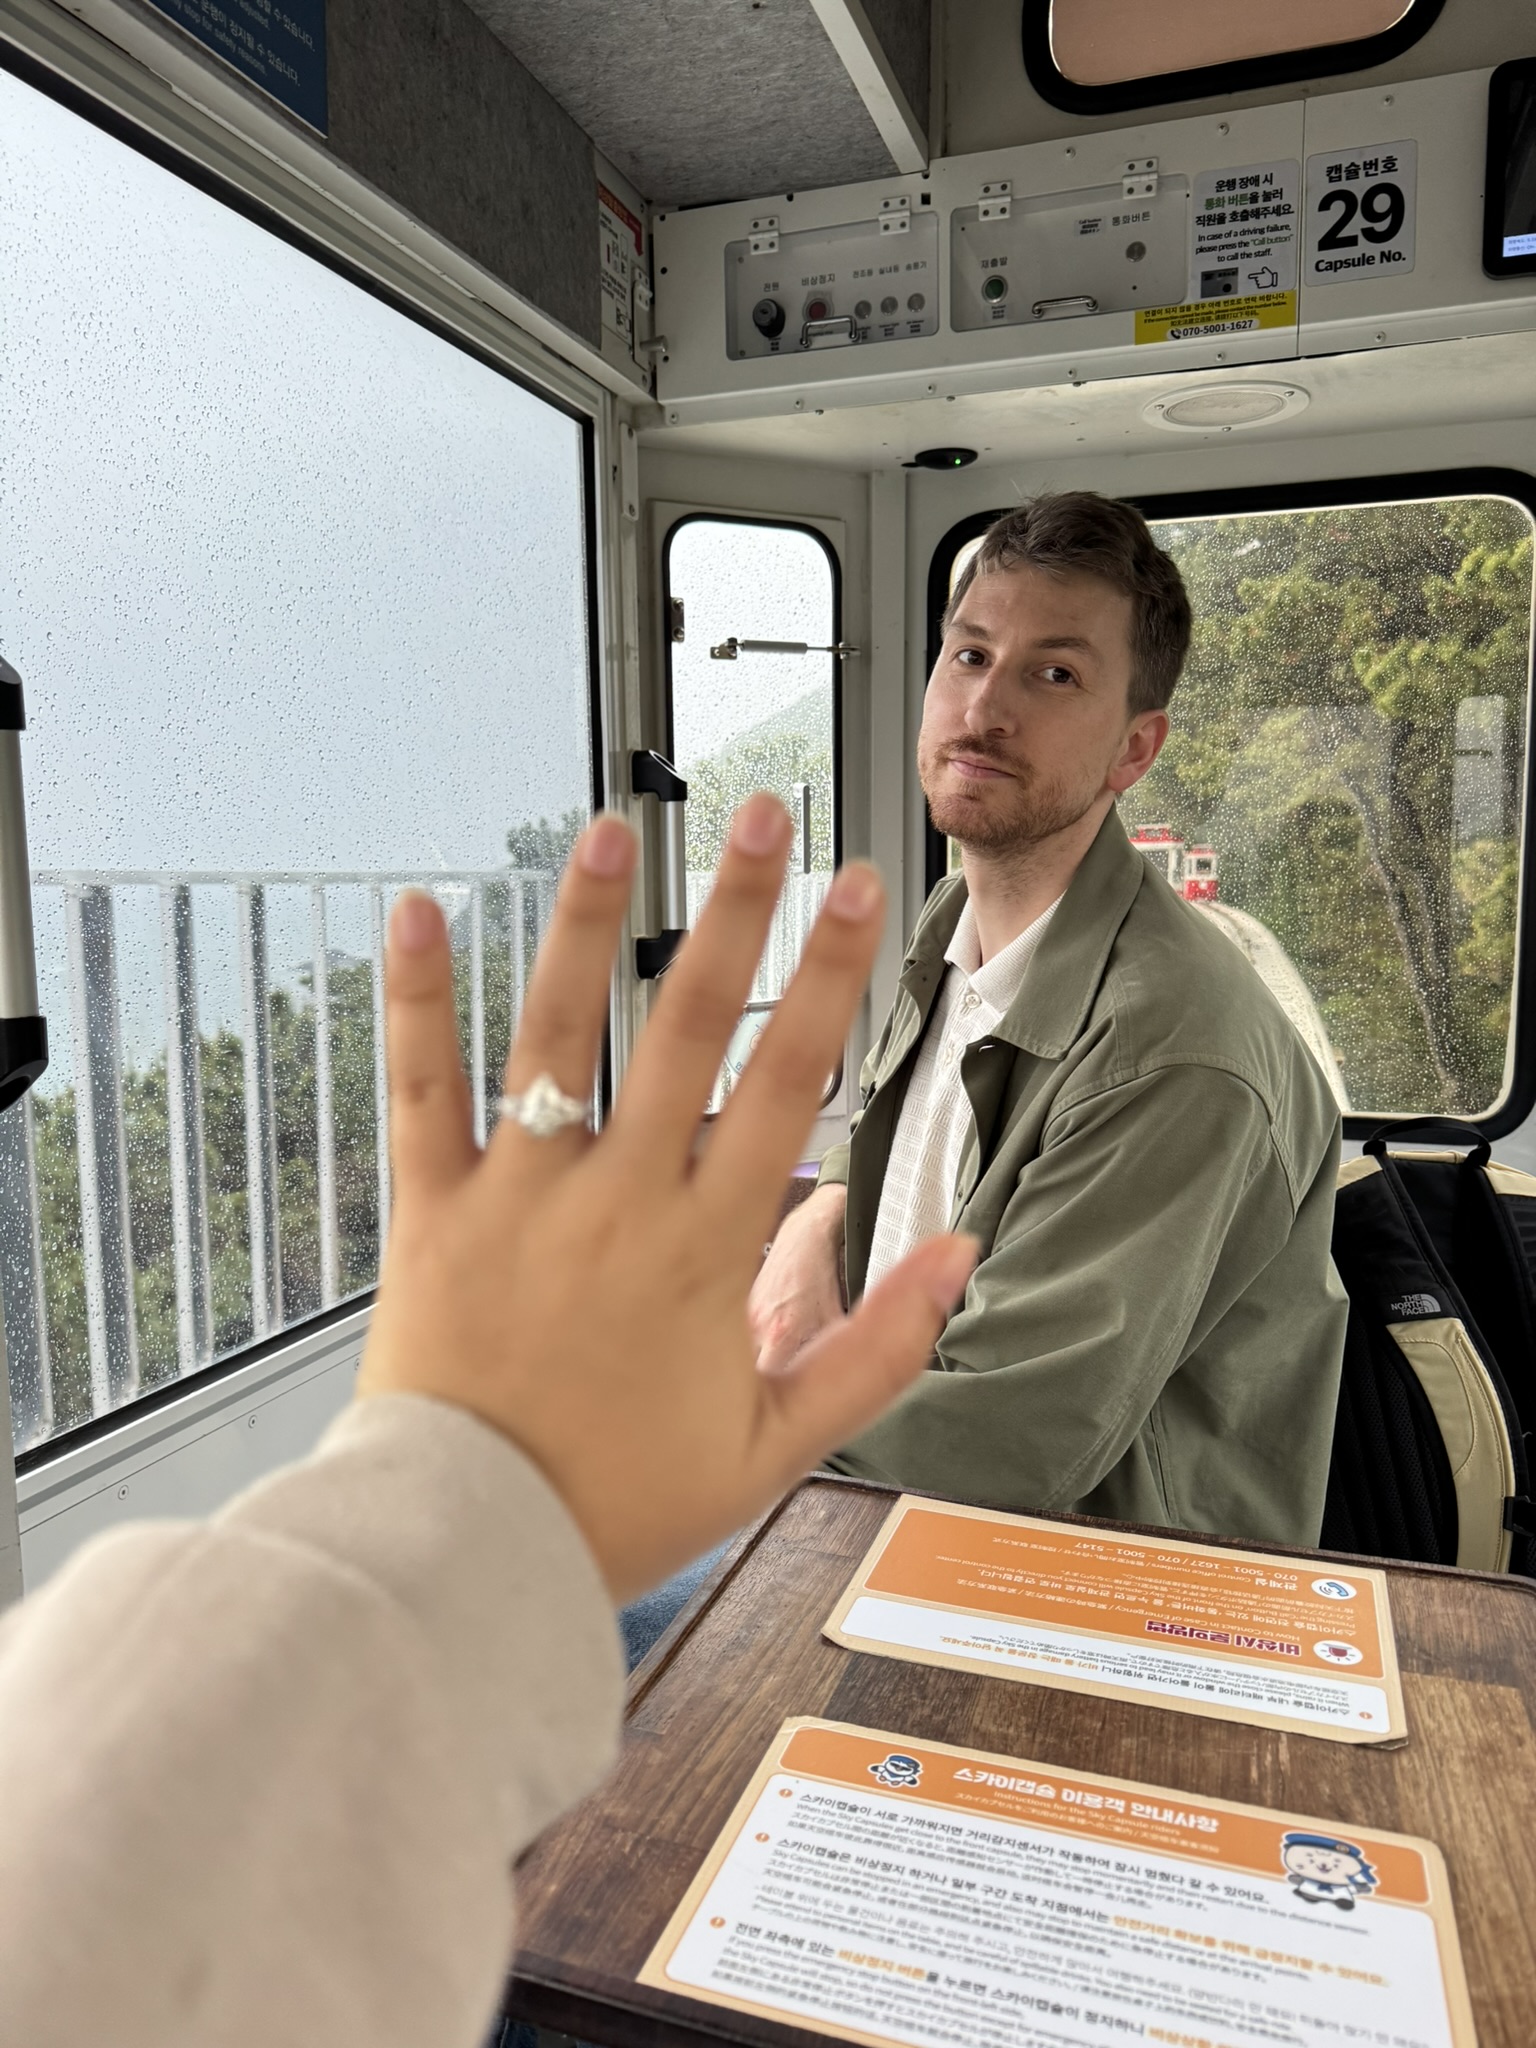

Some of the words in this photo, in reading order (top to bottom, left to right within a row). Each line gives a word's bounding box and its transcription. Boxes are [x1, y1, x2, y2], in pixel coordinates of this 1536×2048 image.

[283, 14, 316, 52] 있습니다.
[229, 21, 255, 51] 정지될
[256, 43, 266, 57] 수
[267, 50, 301, 87] 있습니다.
[1325, 155, 1399, 182] 캡슐번호
[1215, 177, 1236, 192] 운행
[1238, 174, 1259, 189] 장애
[1262, 172, 1273, 186] 시
[1204, 195, 1225, 210] 통화
[1227, 191, 1259, 207] 버튼을
[1261, 187, 1282, 202] 눌러
[1112, 210, 1150, 226] 통화버튼
[1195, 212, 1226, 228] 직원을
[1228, 202, 1294, 223] 호출해주세요.
[1317, 182, 1405, 252] 29
[1198, 234, 1205, 242] In
[1206, 231, 1222, 241] case
[1224, 230, 1232, 239] of
[1233, 229, 1238, 237] a
[1239, 225, 1264, 237] driving
[1266, 222, 1291, 233] failure,
[1195, 244, 1217, 254] please
[1218, 241, 1236, 251] press
[1238, 239, 1249, 248] the
[1251, 237, 1266, 246] "Call
[1266, 233, 1293, 244] button"
[1217, 254, 1224, 262] to
[1226, 252, 1238, 261] call
[1240, 250, 1252, 259] the
[1253, 247, 1272, 257] staff.
[1314, 252, 1376, 274] Capsule
[1379, 248, 1406, 266] No.
[980, 256, 1007, 269] 재출발
[763, 281, 779, 292] 전원
[800, 273, 835, 286] 비상정지
[1144, 308, 1162, 317] 연결이
[1164, 306, 1177, 314] 되지
[1179, 304, 1191, 313] 않을
[1194, 302, 1206, 310] 경우
[1207, 300, 1220, 309] 아래
[1223, 298, 1241, 307] 번호로
[1243, 296, 1257, 304] 연락
[1258, 291, 1287, 302] 바랍니다.
[1182, 319, 1253, 336] 070-5001-1627
[1401, 1294, 1421, 1302] THE
[1390, 1301, 1423, 1310] NORTH
[1401, 1307, 1425, 1316] FACE
[990, 1537, 1028, 1547] 联系方式
[1029, 1543, 1056, 1552] 控制室
[1074, 1541, 1104, 1551] 5147
[1063, 1548, 1144, 1566] 管制室お問い合わせ
[1116, 1547, 1145, 1558] 5001
[1156, 1554, 1180, 1563] 070
[1150, 1562, 1189, 1573] numbers
[1189, 1559, 1219, 1569] 1627
[1232, 1565, 1263, 1576] 5001
[976, 1568, 1036, 1585] 연결됩니다.
[1191, 1568, 1216, 1577] office
[1218, 1572, 1250, 1583] Control
[1273, 1572, 1297, 1582] 070
[955, 1578, 1018, 1594] 紧急联系方法
[1038, 1578, 1062, 1589] 바로
[1064, 1582, 1111, 1597] 관제실로
[1254, 1576, 1297, 1591] 관제실
[1024, 1589, 1108, 1609] 緊急時の連絡方法
[1114, 1591, 1149, 1604] 누르면
[1152, 1597, 1163, 1606] 을
[1114, 1604, 1169, 1619] Emergency
[1165, 1599, 1222, 1616] ‘통화버튼’
[1224, 1609, 1248, 1620] 있는
[1171, 1614, 1182, 1622] of
[1183, 1616, 1207, 1626] Case
[1209, 1620, 1219, 1628] in
[1252, 1613, 1289, 1627] 전면에
[1143, 1617, 1230, 1646] 문의방법
[1221, 1622, 1260, 1635] Contact
[1262, 1629, 1273, 1637] to
[1293, 1620, 1356, 1638] 스카이캡슐
[937, 1635, 992, 1651] 닫아주세요.
[1275, 1631, 1299, 1641] How
[993, 1645, 1004, 1653] 꼭
[1233, 1632, 1300, 1658] 비상시
[1006, 1647, 1037, 1659] 창문을
[1039, 1653, 1062, 1663] 때는
[1063, 1657, 1074, 1666] 올
[1076, 1660, 1098, 1670] 비가
[1101, 1664, 1144, 1678] 위험하니
[1146, 1672, 1190, 1686] 들어가면
[1193, 1681, 1214, 1691] 물이
[1218, 1685, 1263, 1699] 배터리에
[1266, 1694, 1289, 1704] 내부
[1293, 1698, 1350, 1715] 스카이캡슐
[952, 1766, 1057, 1800] 스카이캡슐
[1059, 1787, 1125, 1814] 이용객
[1129, 1801, 1219, 1834] 안내사항
[992, 1790, 1051, 1809] Instructions
[1052, 1803, 1067, 1812] for
[1068, 1806, 1086, 1816] the
[1087, 1810, 1106, 1820] Sky
[1107, 1814, 1148, 1829] Capsule
[1150, 1823, 1181, 1836] riders
[798, 1793, 872, 1816] 스카이캡슐이
[872, 1809, 899, 1823] 서로
[899, 1815, 963, 1836] 가까워지면
[964, 1829, 1055, 1857] 거리감지센서가
[1057, 1849, 1110, 1869] 작동하여
[1113, 1861, 1139, 1876] 잠시
[1143, 1868, 1184, 1885] 멈췄다
[1189, 1877, 1201, 1889] 갈
[1206, 1881, 1219, 1893] 수
[1224, 1885, 1269, 1904] 있어요.
[774, 1838, 852, 1863] 스카이캡슐은
[852, 1856, 906, 1876] 비상정지
[906, 1868, 947, 1886] 하거나
[949, 1878, 977, 1893] 일부
[980, 1885, 1008, 1900] 구간
[1009, 1892, 1038, 1907] 도착
[1040, 1899, 1109, 1924] 지점에서는
